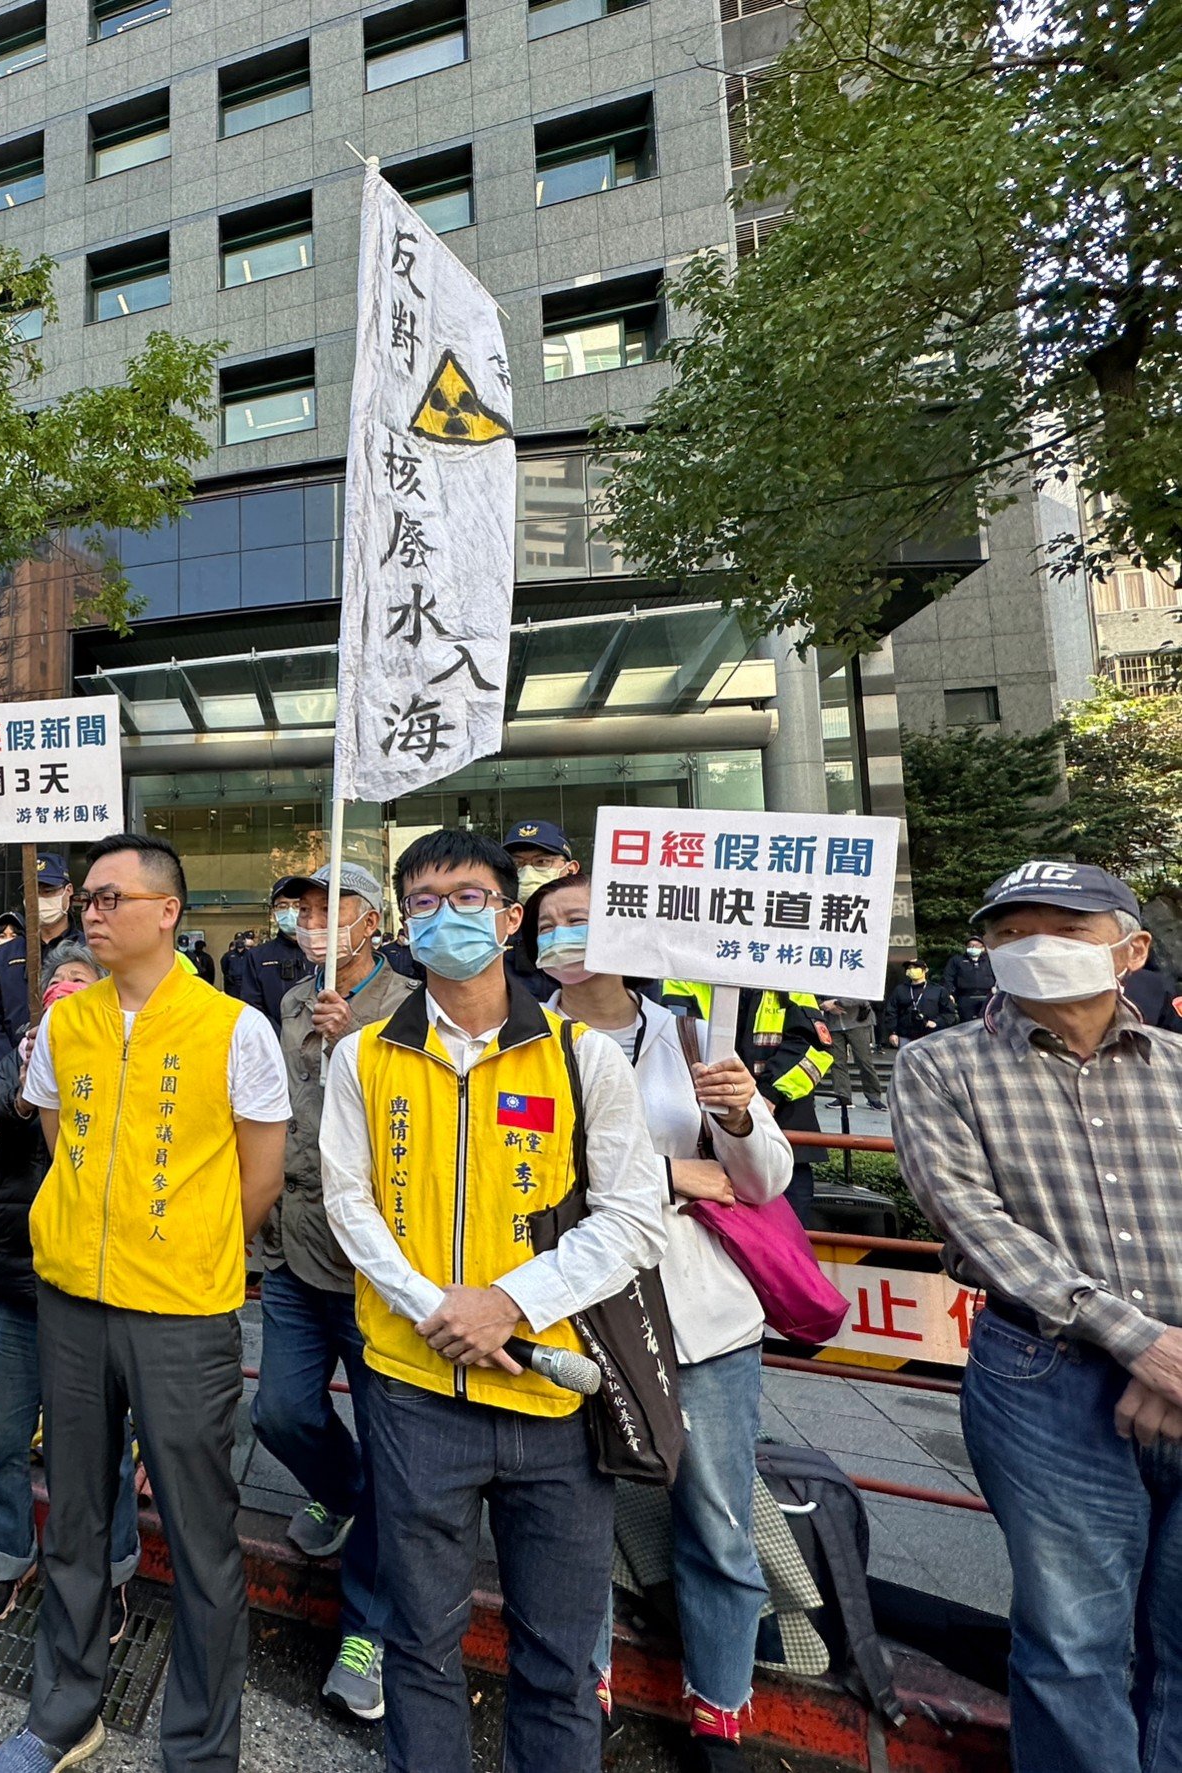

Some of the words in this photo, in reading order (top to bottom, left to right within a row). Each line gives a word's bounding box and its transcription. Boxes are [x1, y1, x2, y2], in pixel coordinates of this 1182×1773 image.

[16, 803, 110, 825] 游智彬團隊
[610, 829, 874, 878] 日經假新聞
[606, 880, 870, 935] 無恥快道歉
[716, 939, 866, 971] 游智彬團隊
[68, 1073, 94, 1172] 游智彬
[147, 1052, 181, 1242] 桃園市議員參選人
[504, 1130, 544, 1155] 新黨
[389, 1095, 410, 1239] 輿情中心主任
